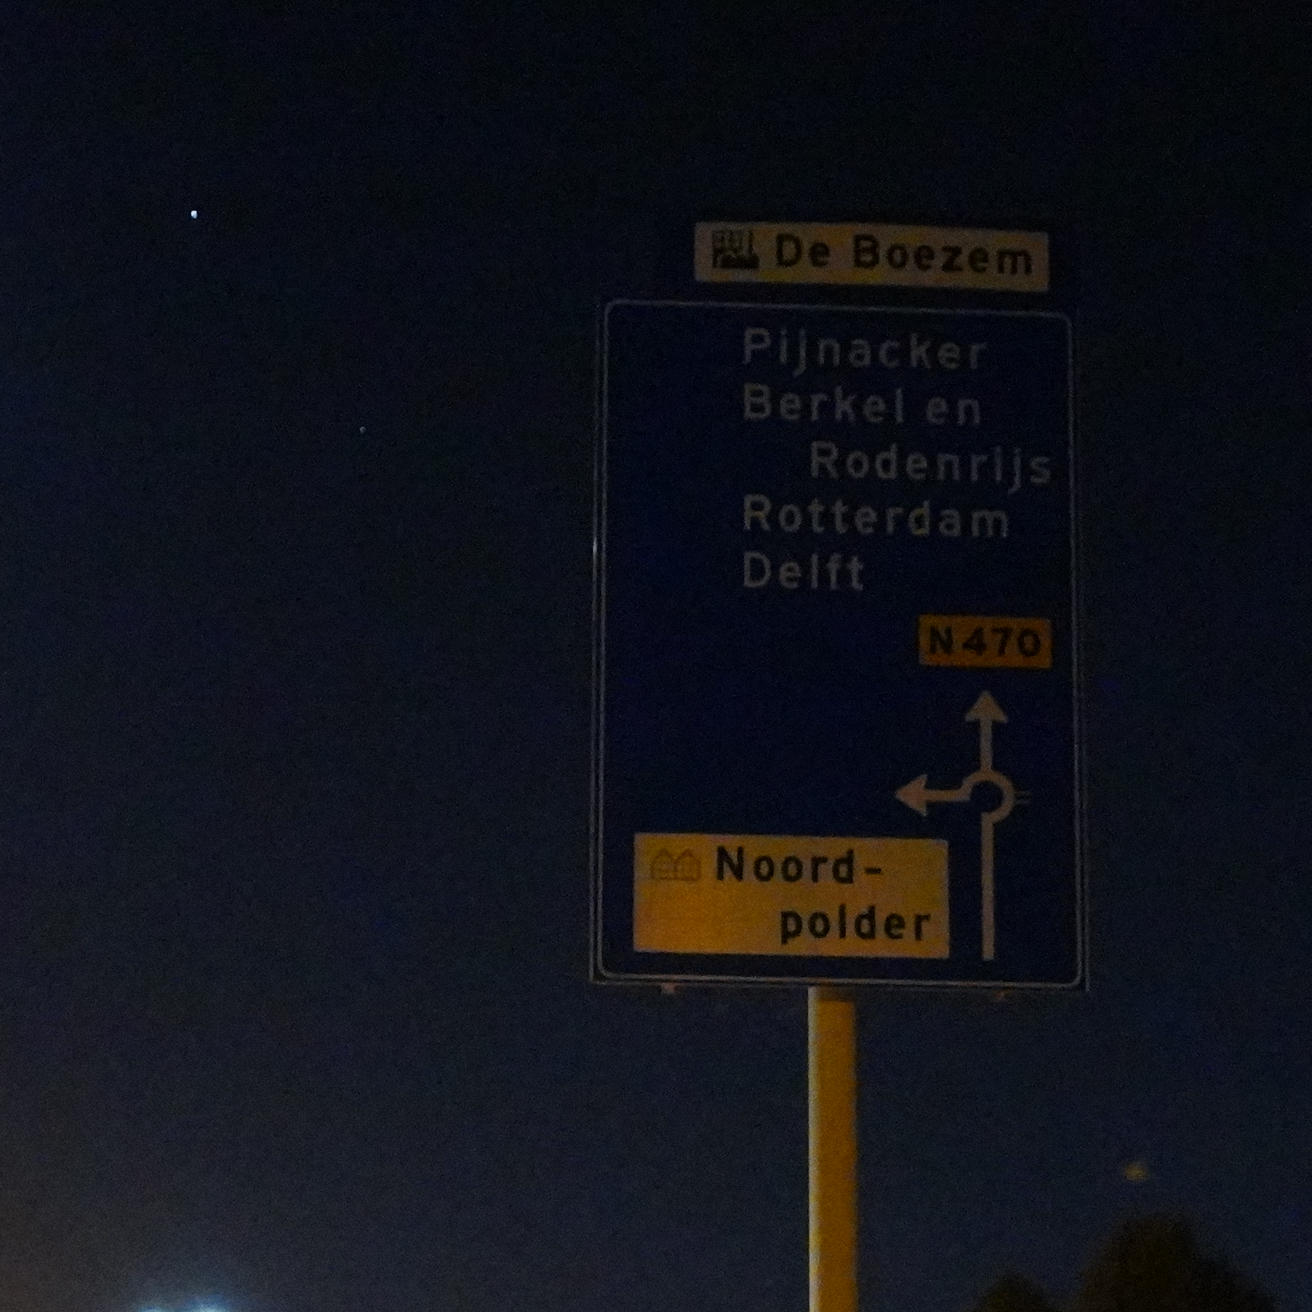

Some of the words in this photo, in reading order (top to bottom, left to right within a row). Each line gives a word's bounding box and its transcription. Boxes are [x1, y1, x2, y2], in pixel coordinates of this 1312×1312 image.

[775, 233, 831, 268] De
[853, 234, 1033, 274] Boezem
[742, 326, 988, 377] Pijnacker
[743, 382, 905, 425] Berkel
[924, 396, 981, 427] en
[809, 440, 1052, 495] Rodenrijs
[743, 493, 1009, 538] Rotterdam
[743, 550, 865, 592] Delft
[716, 846, 883, 884] Noord-
[781, 903, 931, 946] polder
